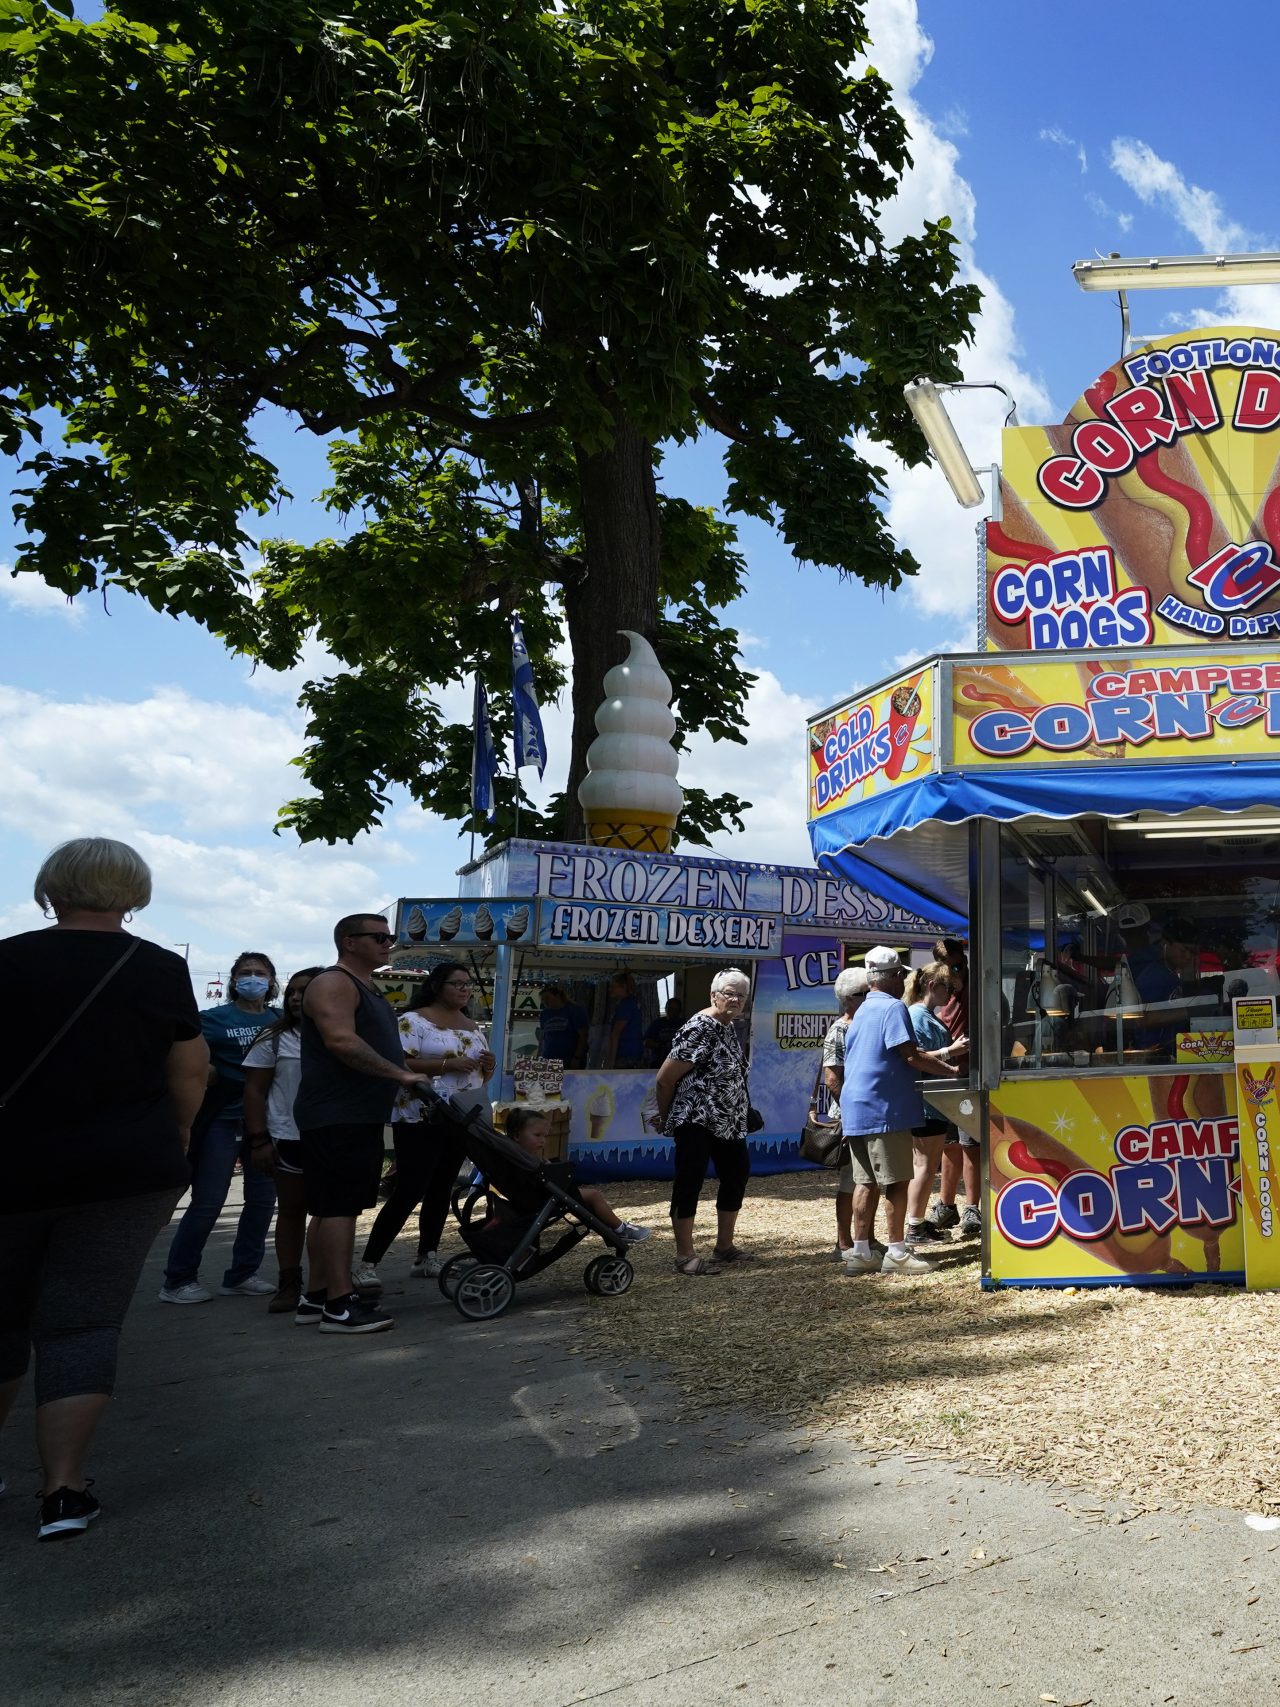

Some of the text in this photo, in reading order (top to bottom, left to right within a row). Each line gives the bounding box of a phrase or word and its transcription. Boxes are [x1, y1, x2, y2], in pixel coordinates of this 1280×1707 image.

[1039, 370, 1220, 507] CORN
[994, 548, 1114, 620] CORN
[1031, 590, 1150, 649] DOGS
[1158, 596, 1224, 634] HAND
[824, 706, 873, 764] COLD
[970, 695, 1212, 755] CORN
[816, 724, 892, 808] DRINKS
[534, 851, 749, 911] FROZEN
[552, 905, 776, 950] FROZEN DESSERT
[782, 950, 838, 991] ICE
[226, 1026, 262, 1038] HEROES
[1180, 1041, 1204, 1050] CORN
[1222, 1040, 1234, 1048] DO
[1254, 1111, 1270, 1172] CORN
[997, 1159, 1236, 1246] CORN
[1258, 1176, 1274, 1238] DOGS
